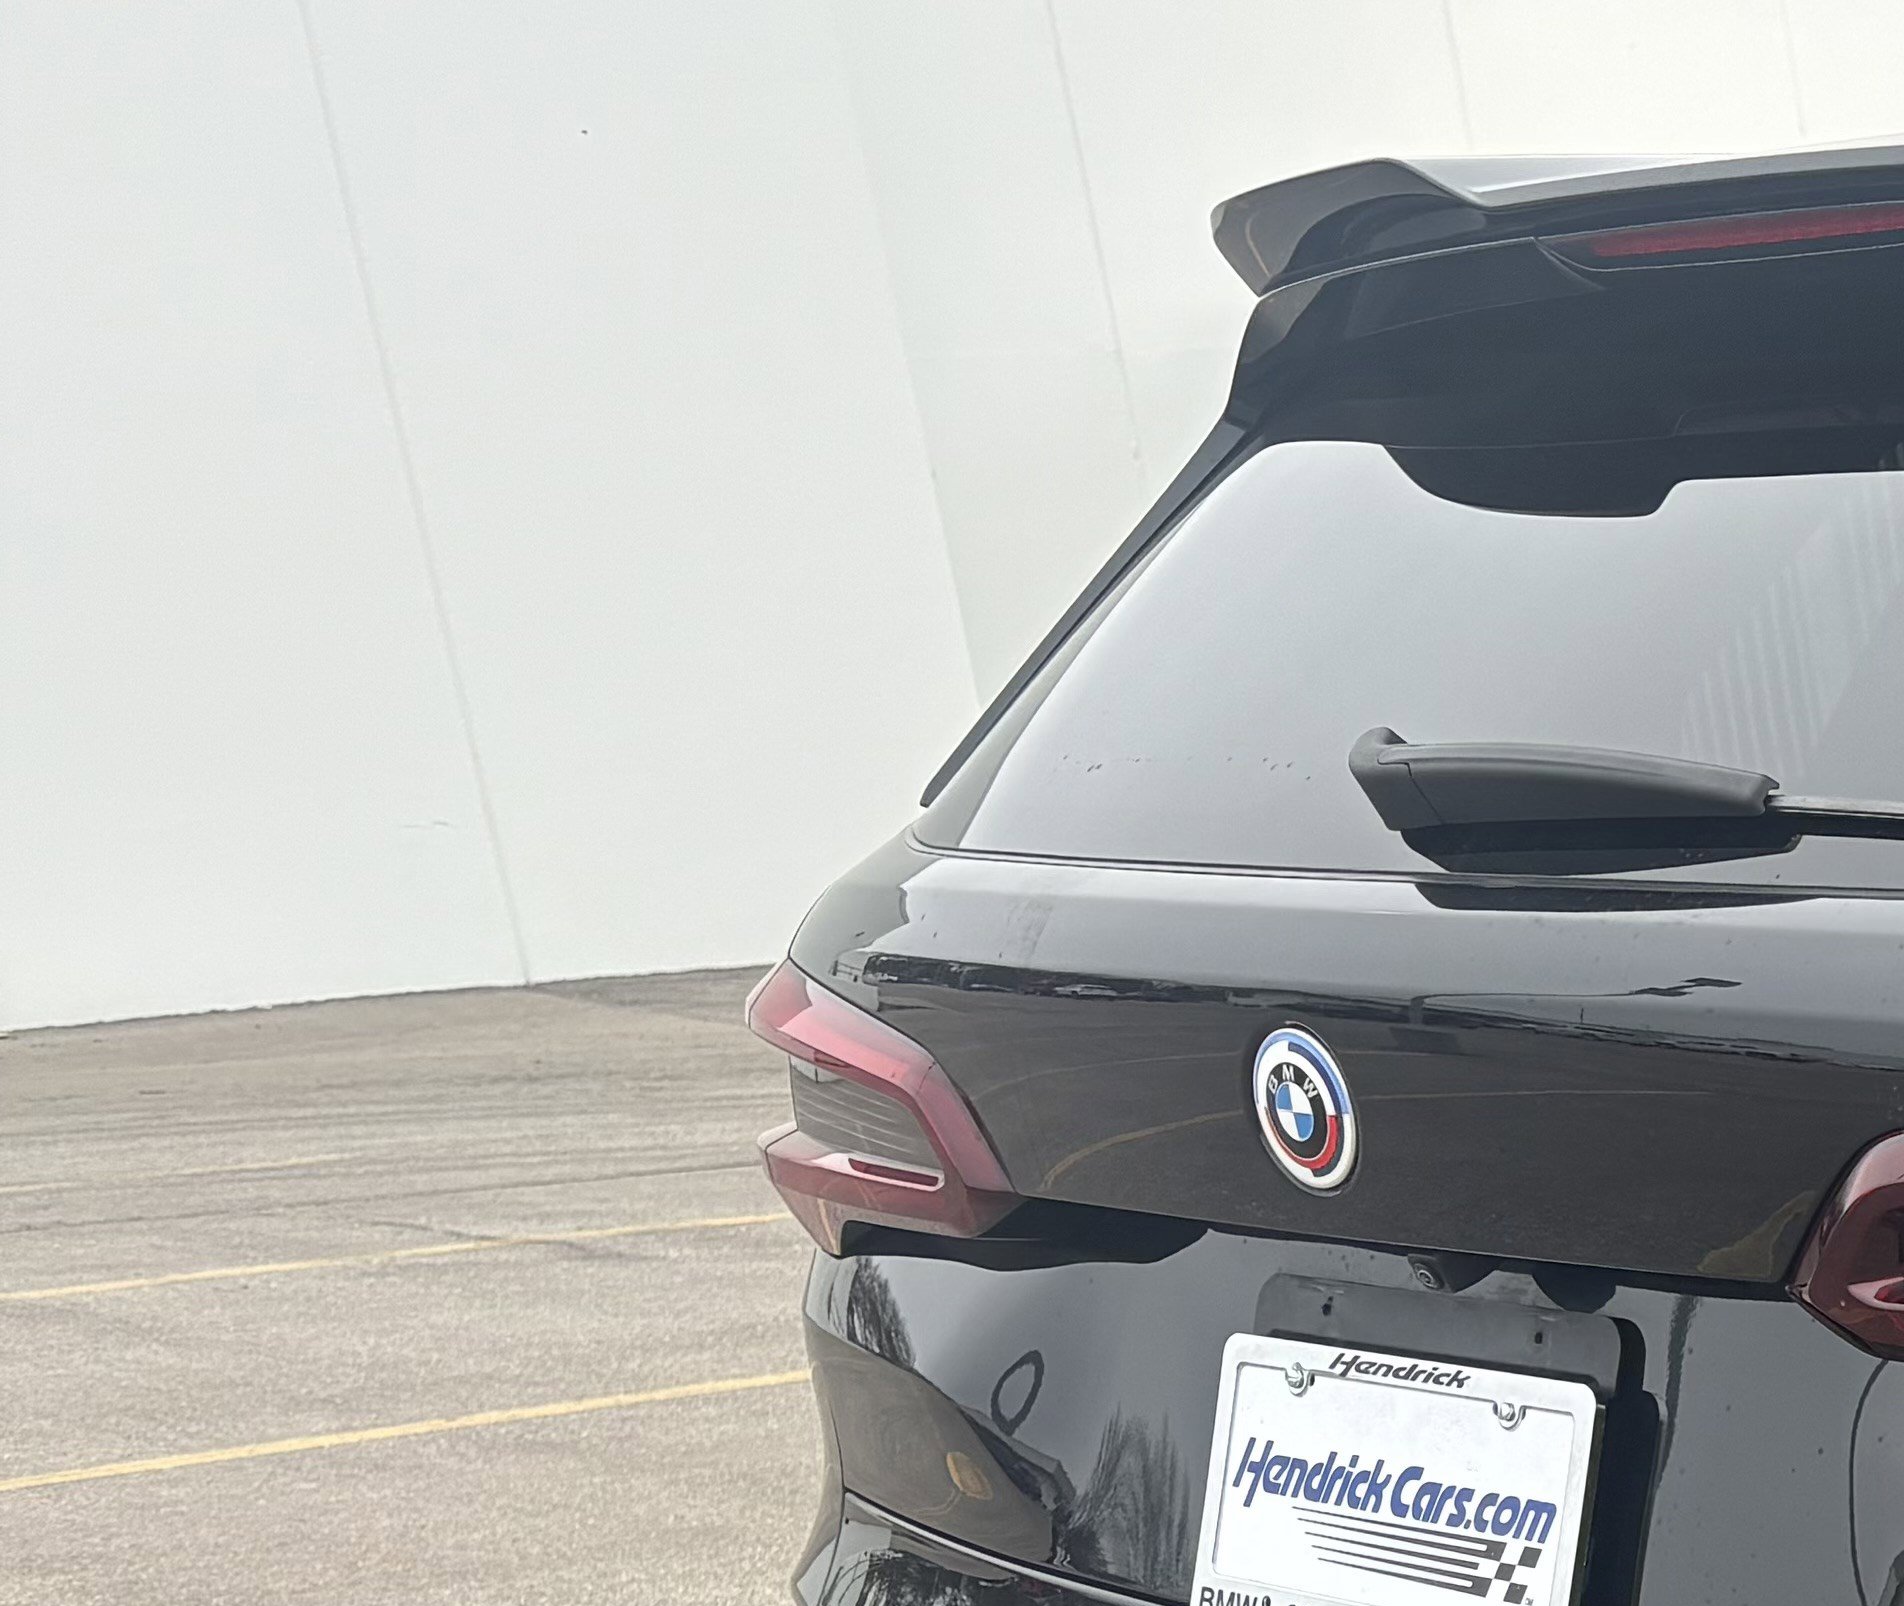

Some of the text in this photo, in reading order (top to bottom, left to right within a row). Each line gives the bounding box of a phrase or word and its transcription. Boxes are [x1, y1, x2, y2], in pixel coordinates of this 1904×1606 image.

[1268, 1064, 1320, 1098] BMW
[1328, 1352, 1471, 1388] Hendrick
[1232, 1437, 1557, 1544] HendrickCars.com
